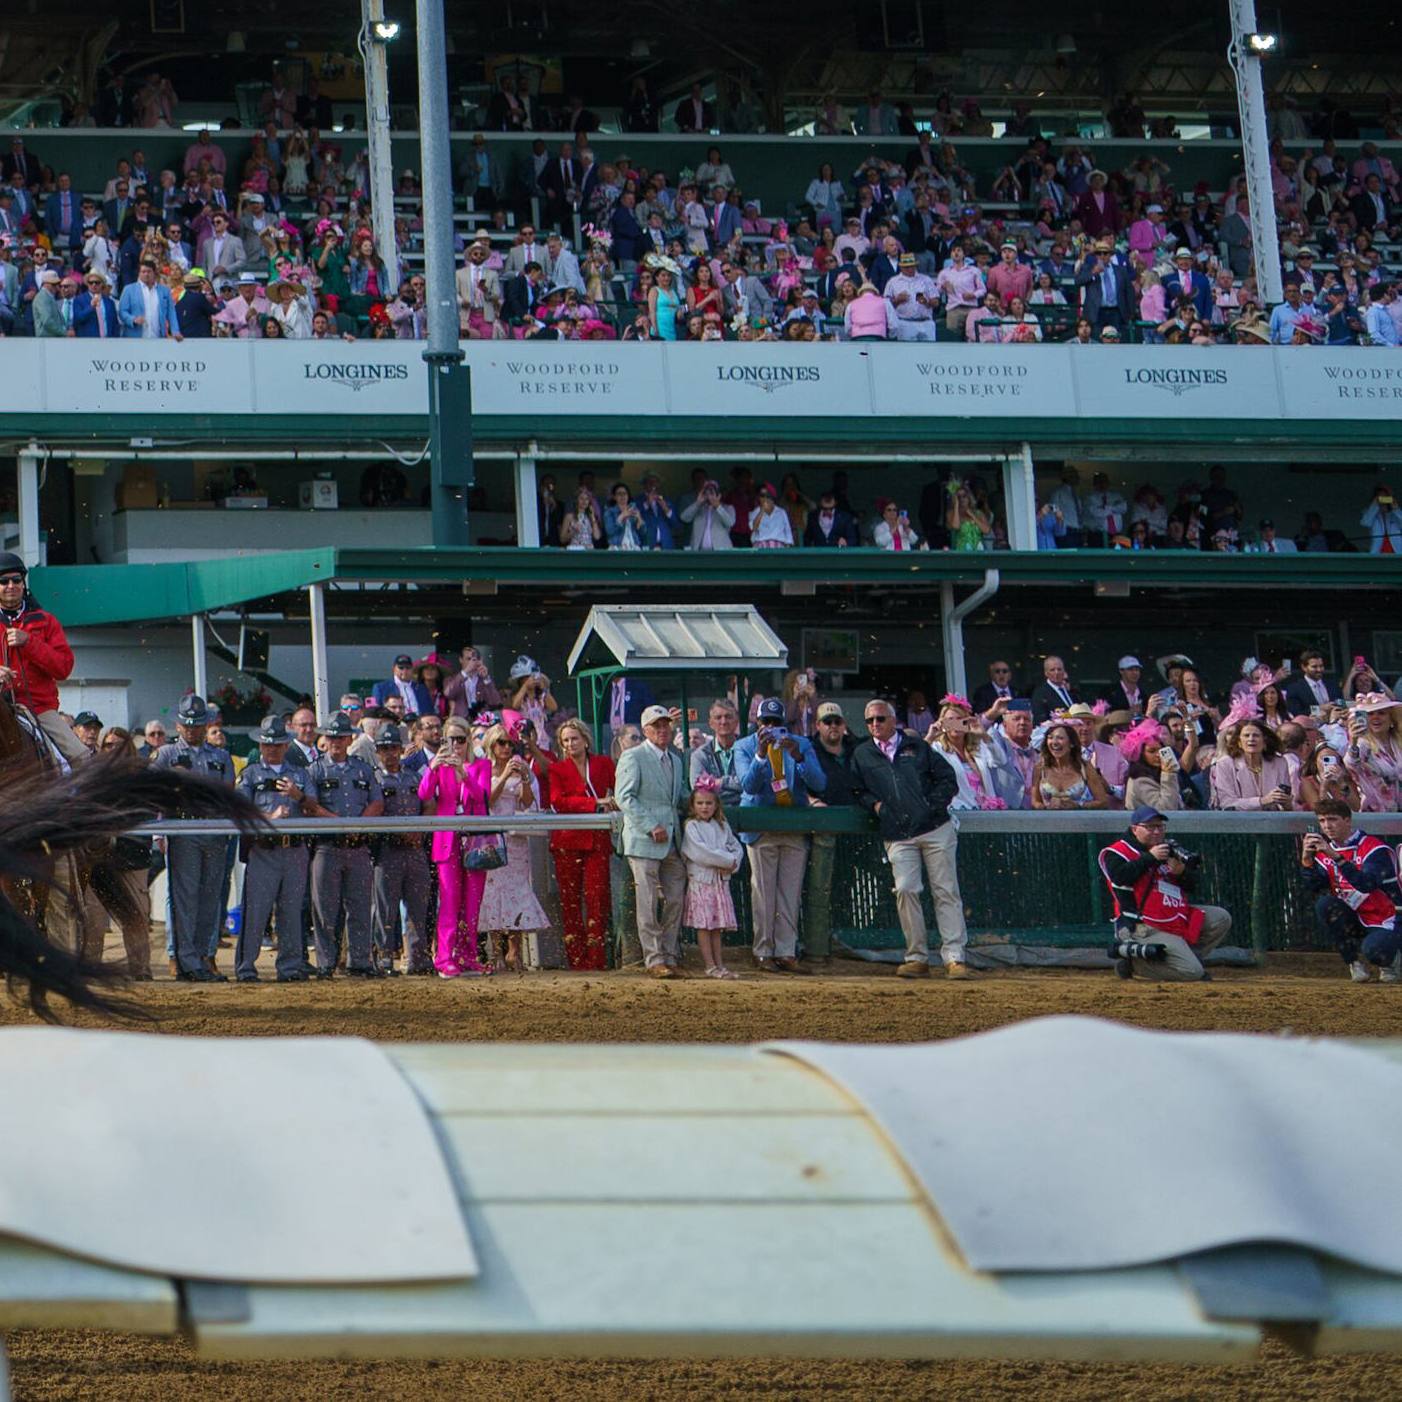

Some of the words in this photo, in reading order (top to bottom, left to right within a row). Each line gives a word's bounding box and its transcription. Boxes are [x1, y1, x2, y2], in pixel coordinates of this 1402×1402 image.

[91, 360, 206, 373] WOODFORD
[304, 364, 408, 379] LONGINES
[506, 362, 619, 375] WOODFORD
[916, 363, 1028, 377] WOODFORD
[717, 366, 821, 381] LONGINES
[1125, 368, 1228, 384] LONGINES
[105, 379, 198, 392] RESERVE
[520, 381, 613, 394] RESERVE
[930, 382, 1022, 395] RESERVE
[1338, 385, 1402, 399] RESER
